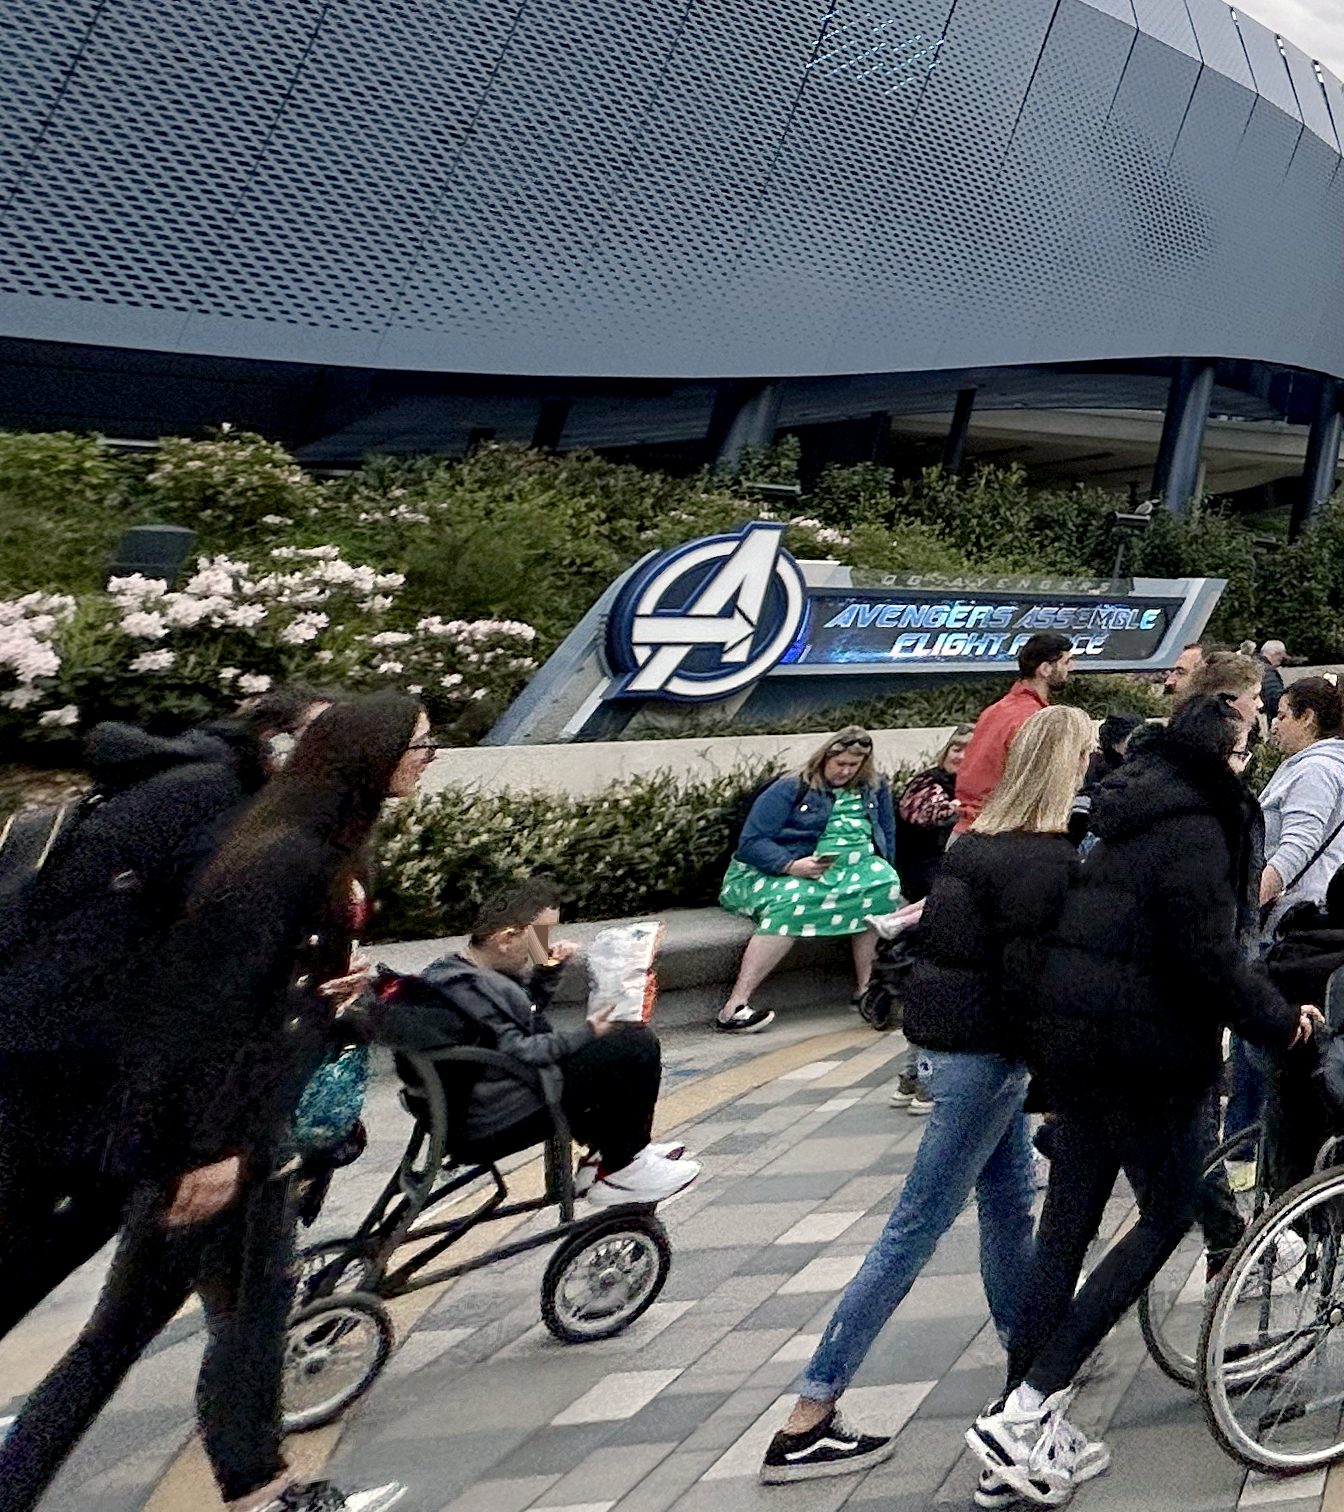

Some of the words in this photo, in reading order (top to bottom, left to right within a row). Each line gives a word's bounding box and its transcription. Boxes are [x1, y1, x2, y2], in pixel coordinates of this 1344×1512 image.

[949, 576, 1111, 592] AVENGERS
[824, 603, 1012, 628] AVENGERS
[1012, 607, 1162, 630] ASSEMBLE
[889, 633, 1012, 658] FLIGHT
[1008, 633, 1108, 655] FCE
